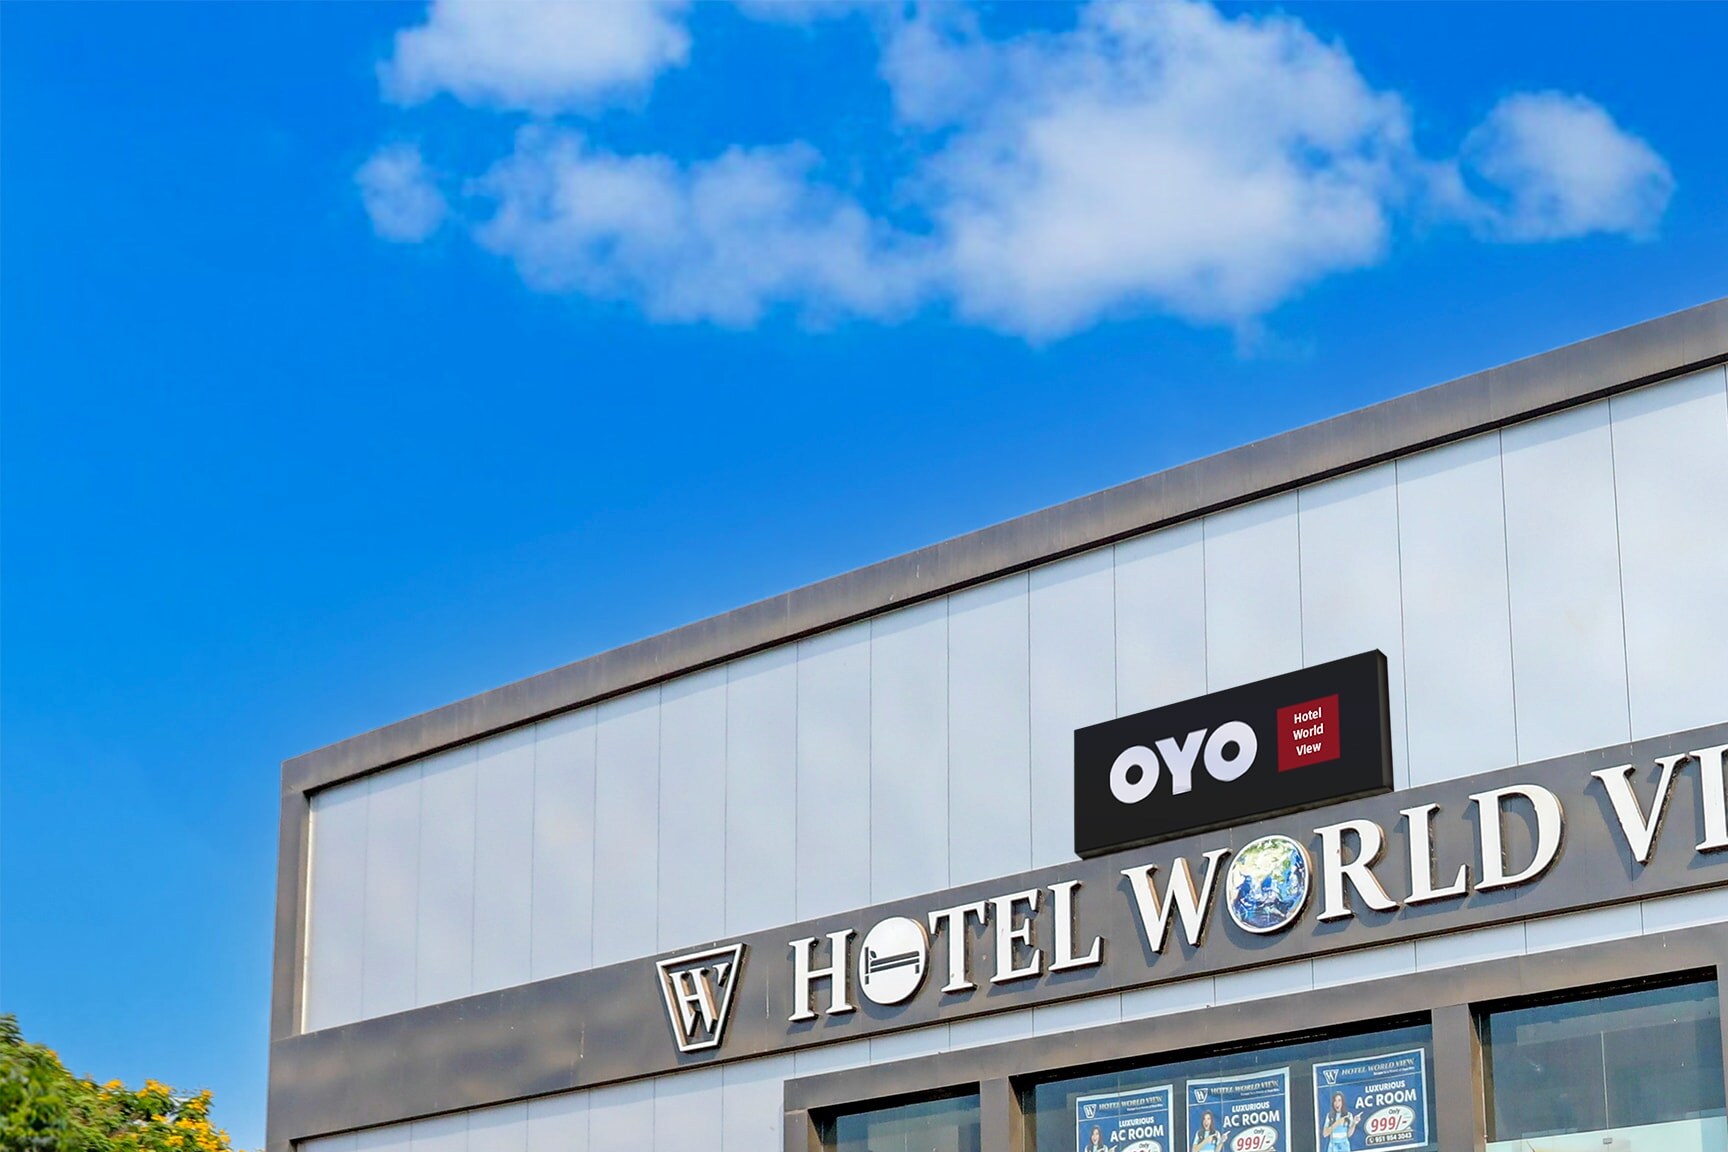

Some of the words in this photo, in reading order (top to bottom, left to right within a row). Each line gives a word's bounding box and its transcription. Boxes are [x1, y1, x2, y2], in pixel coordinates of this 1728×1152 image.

[1293, 706, 1322, 724] Hotel
[1292, 722, 1324, 741] World
[1109, 720, 1258, 804] OYO
[788, 879, 1102, 1022] HOTEL
[1121, 784, 1566, 954] WORLD
[1365, 1080, 1405, 1093] LUXURIOUS
[1232, 1101, 1270, 1113] LUXURIOUS
[1355, 1096, 1373, 1109] AC
[1376, 1089, 1417, 1105] ROOM
[1119, 1116, 1154, 1127] LUXURIOUS
[1223, 1115, 1239, 1128] AC
[1242, 1110, 1280, 1126] ROOM
[1371, 1115, 1407, 1132] 999/-
[1110, 1130, 1126, 1142] AC
[1128, 1125, 1164, 1140] ROOM
[1237, 1135, 1270, 1151] 999/-
